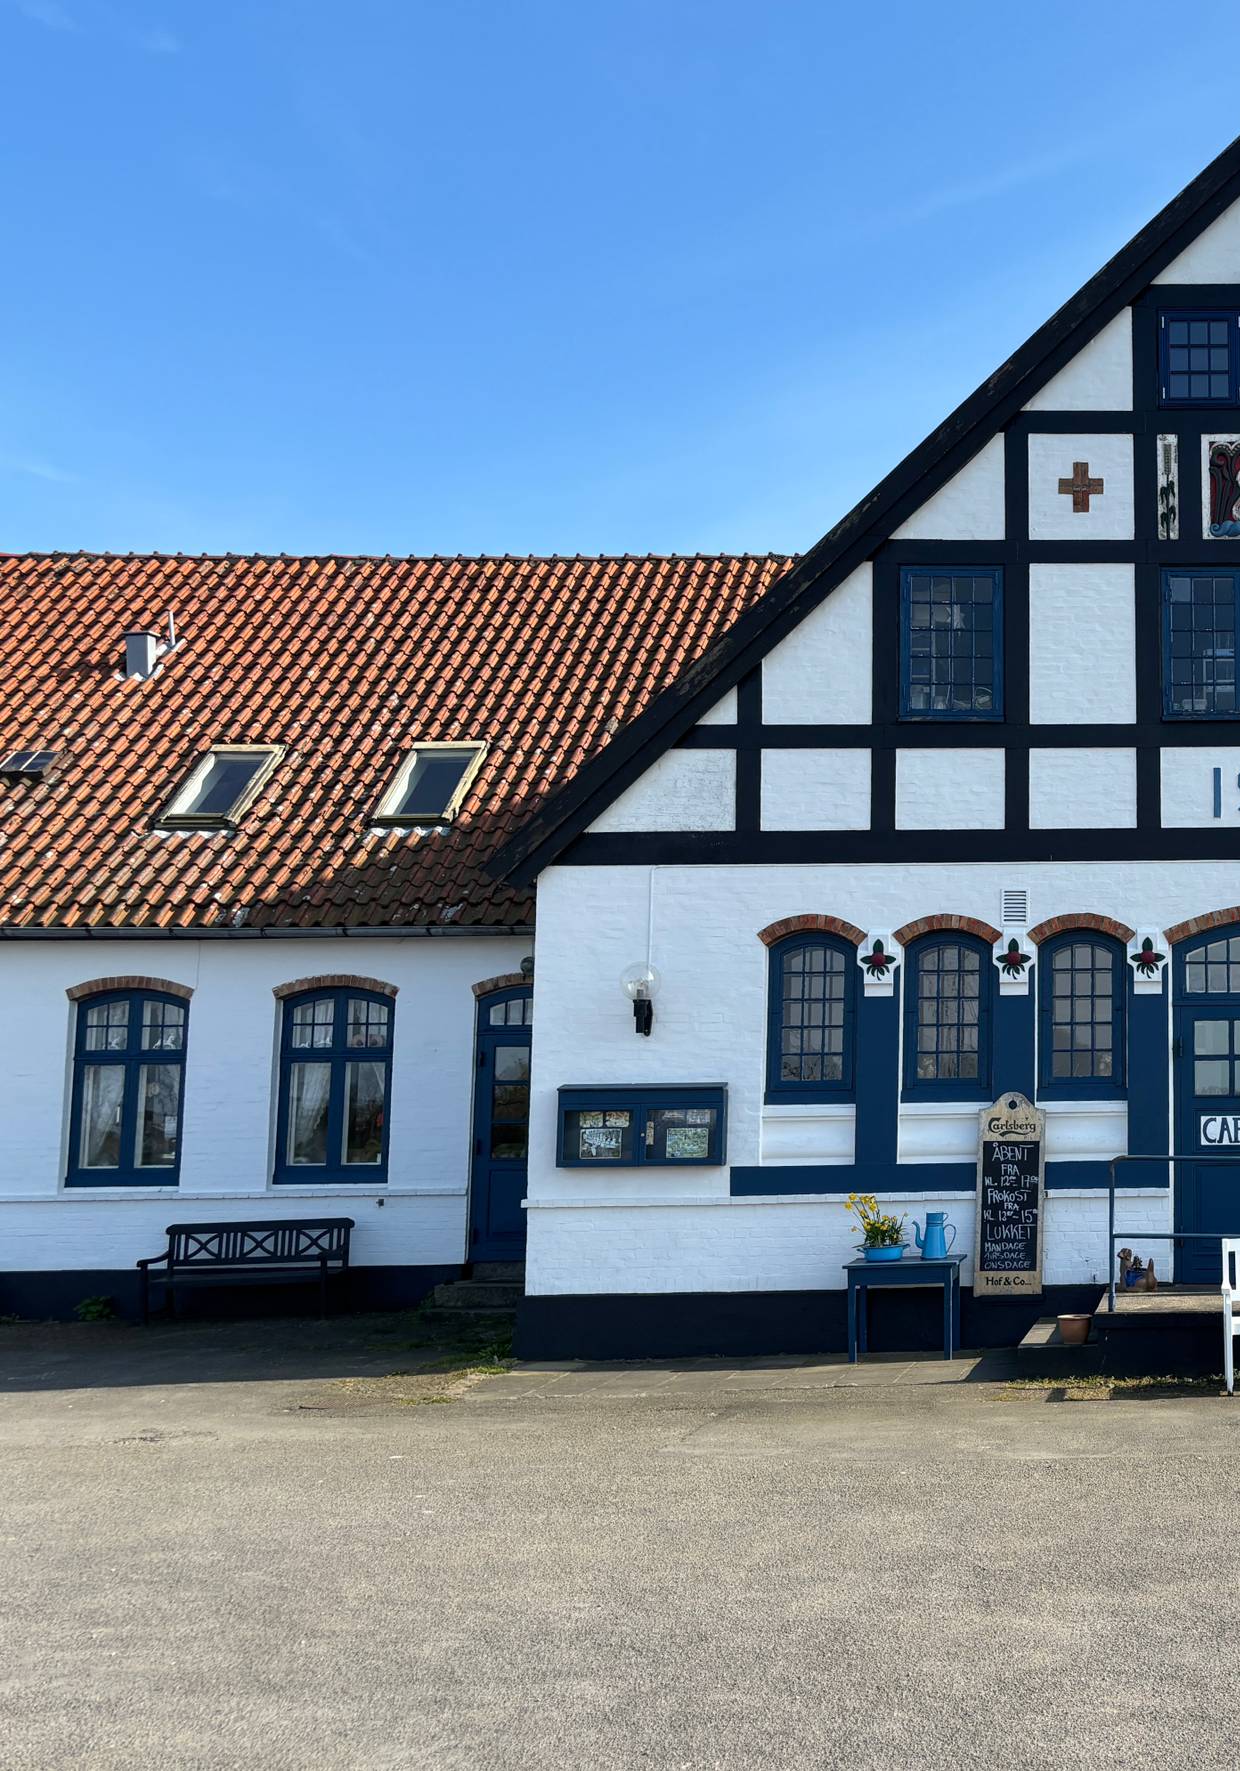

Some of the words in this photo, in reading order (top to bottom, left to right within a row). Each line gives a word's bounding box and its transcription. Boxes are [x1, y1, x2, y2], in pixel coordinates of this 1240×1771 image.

[988, 1117, 1036, 1135] Carlsberg
[992, 1142, 1034, 1162] ÅBENT
[1001, 1163, 1020, 1176] FRA
[1004, 1202, 1020, 1211] FRA
[986, 1223, 1037, 1241] LUKKET
[984, 1241, 1026, 1252] MANDAGE
[984, 1260, 1031, 1270] ONSDAGE
[985, 1276, 1003, 1286] Hof
[1003, 1276, 1012, 1286] &
